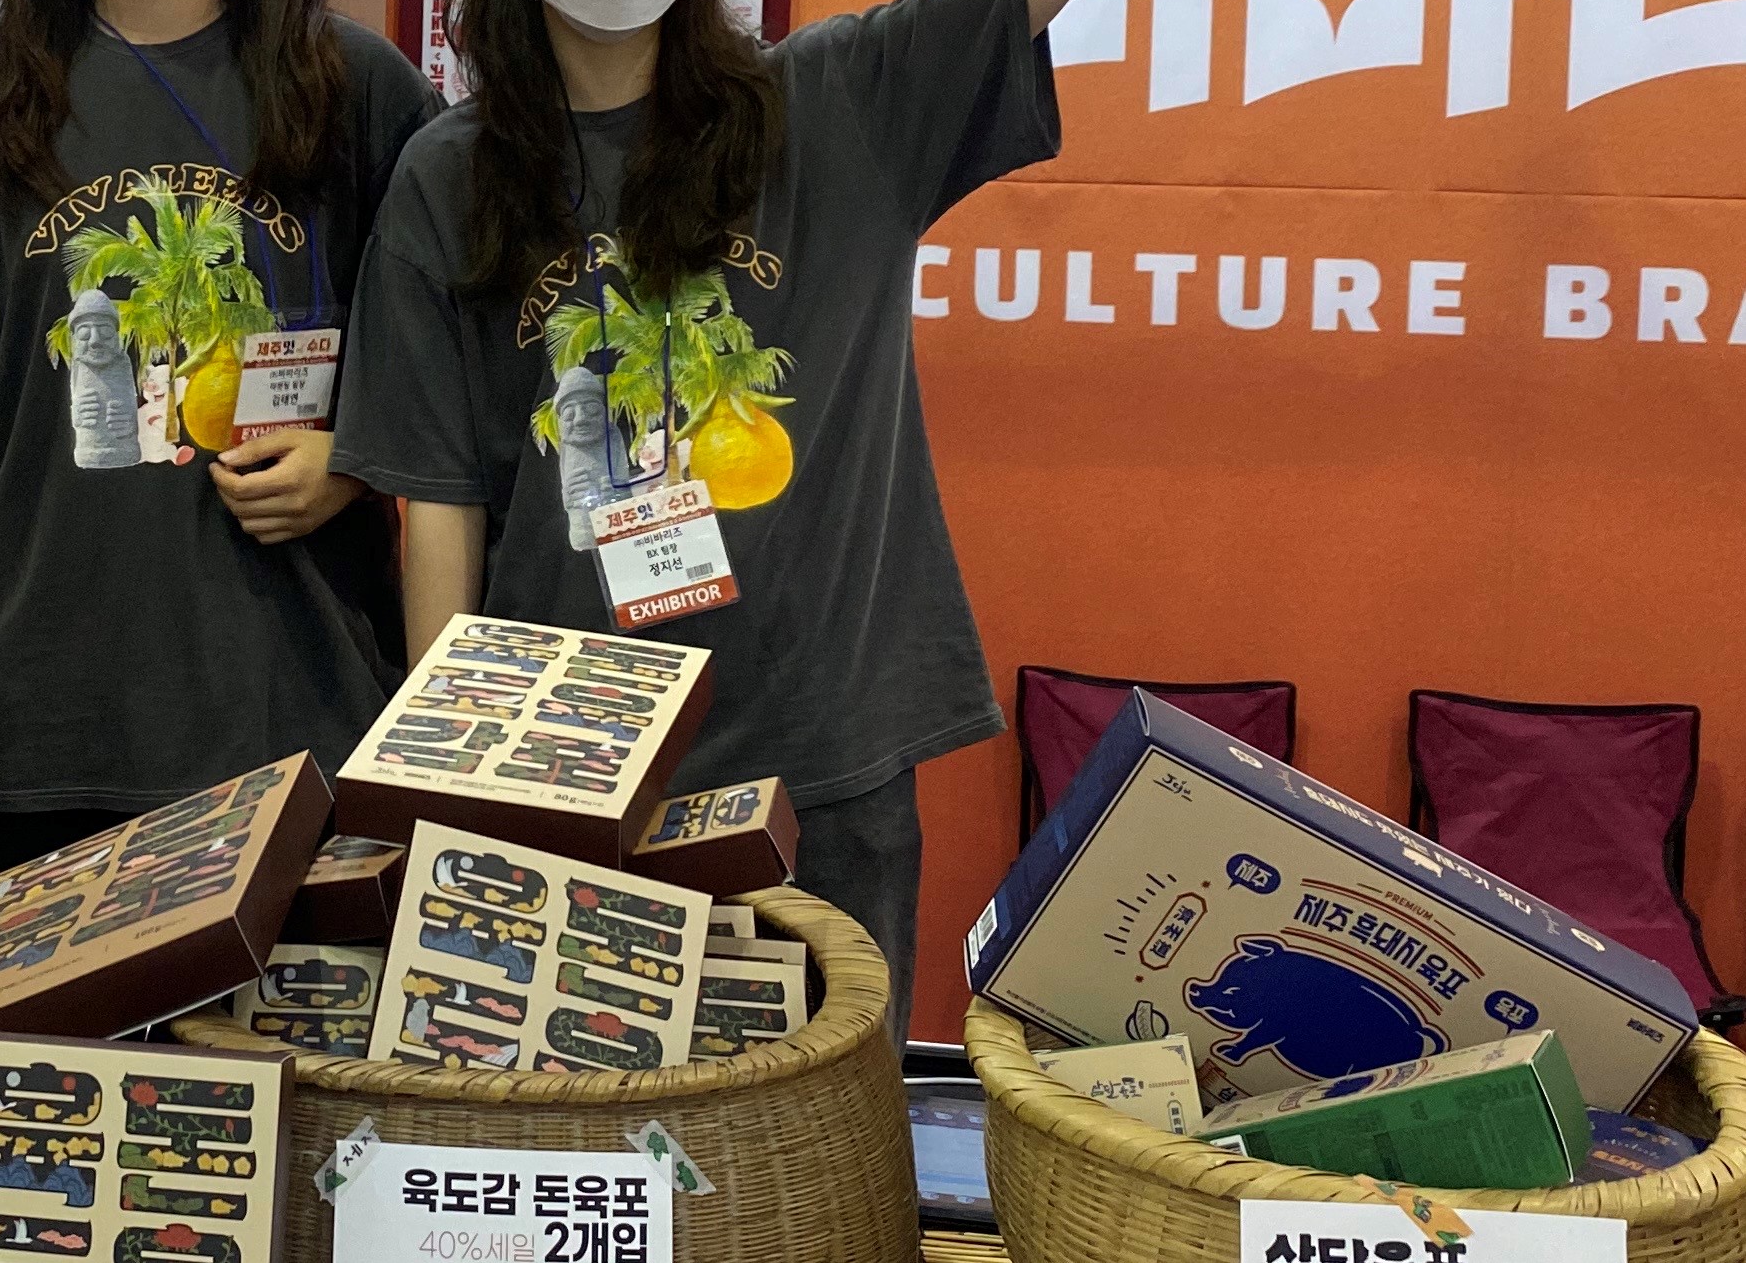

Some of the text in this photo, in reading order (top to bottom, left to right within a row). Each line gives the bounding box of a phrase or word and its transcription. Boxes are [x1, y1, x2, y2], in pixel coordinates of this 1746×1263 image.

[910, 245, 1746, 345] CULTURE BR
[307, 337, 331, 354] 수다
[668, 490, 699, 511] 수다
[649, 556, 684, 576] 정지선
[629, 584, 722, 621] EXHIBITOR
[1161, 772, 1192, 795] Jeju
[1234, 859, 1273, 888] 제주
[1384, 891, 1434, 922] PREMIUM
[1293, 893, 1471, 1001] 제주 흑돼지 육포
[1494, 996, 1529, 1025] 육포
[402, 1168, 650, 1219] 육도감 돈육포
[419, 1221, 648, 1263] 40%세일 2개입
